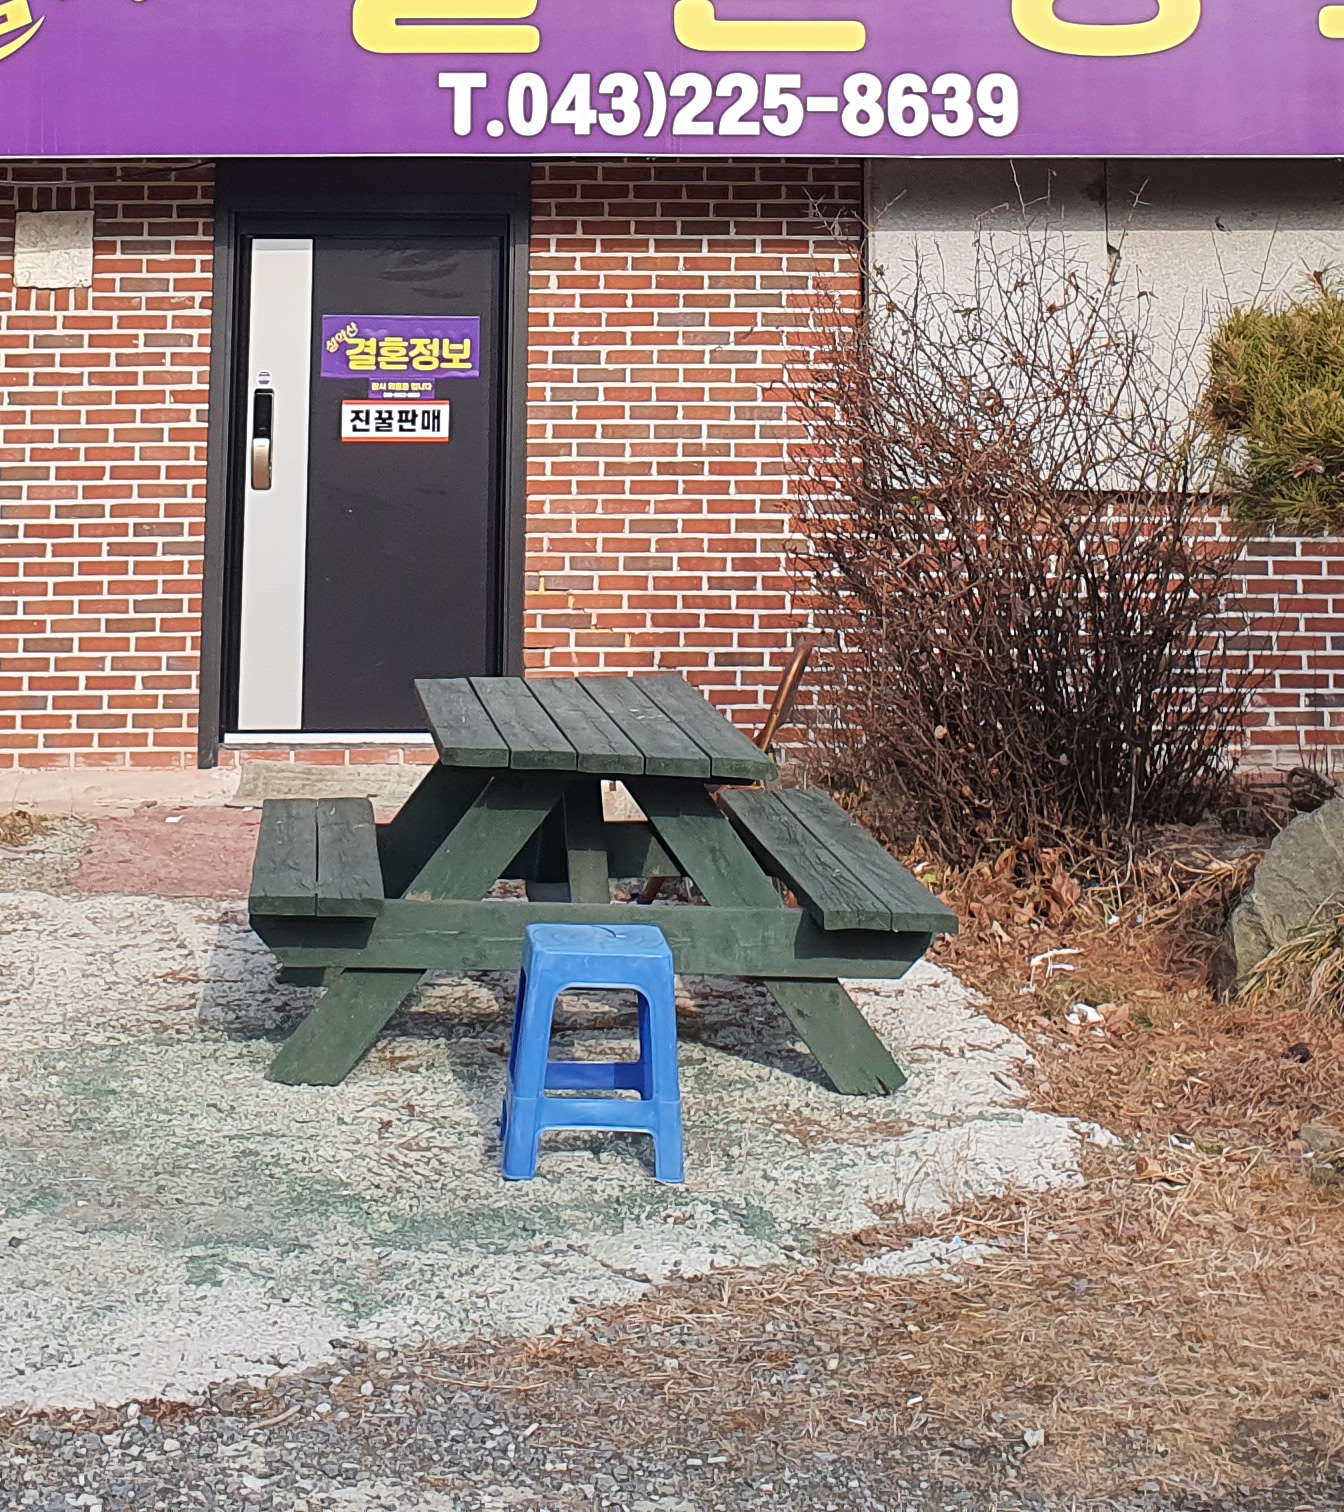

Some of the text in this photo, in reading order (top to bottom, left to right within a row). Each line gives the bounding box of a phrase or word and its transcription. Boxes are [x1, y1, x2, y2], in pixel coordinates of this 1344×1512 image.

[438, 71, 1020, 138] T.043)225-8639
[345, 336, 473, 371] 결혼정보
[349, 409, 442, 433] 진꿀판매
